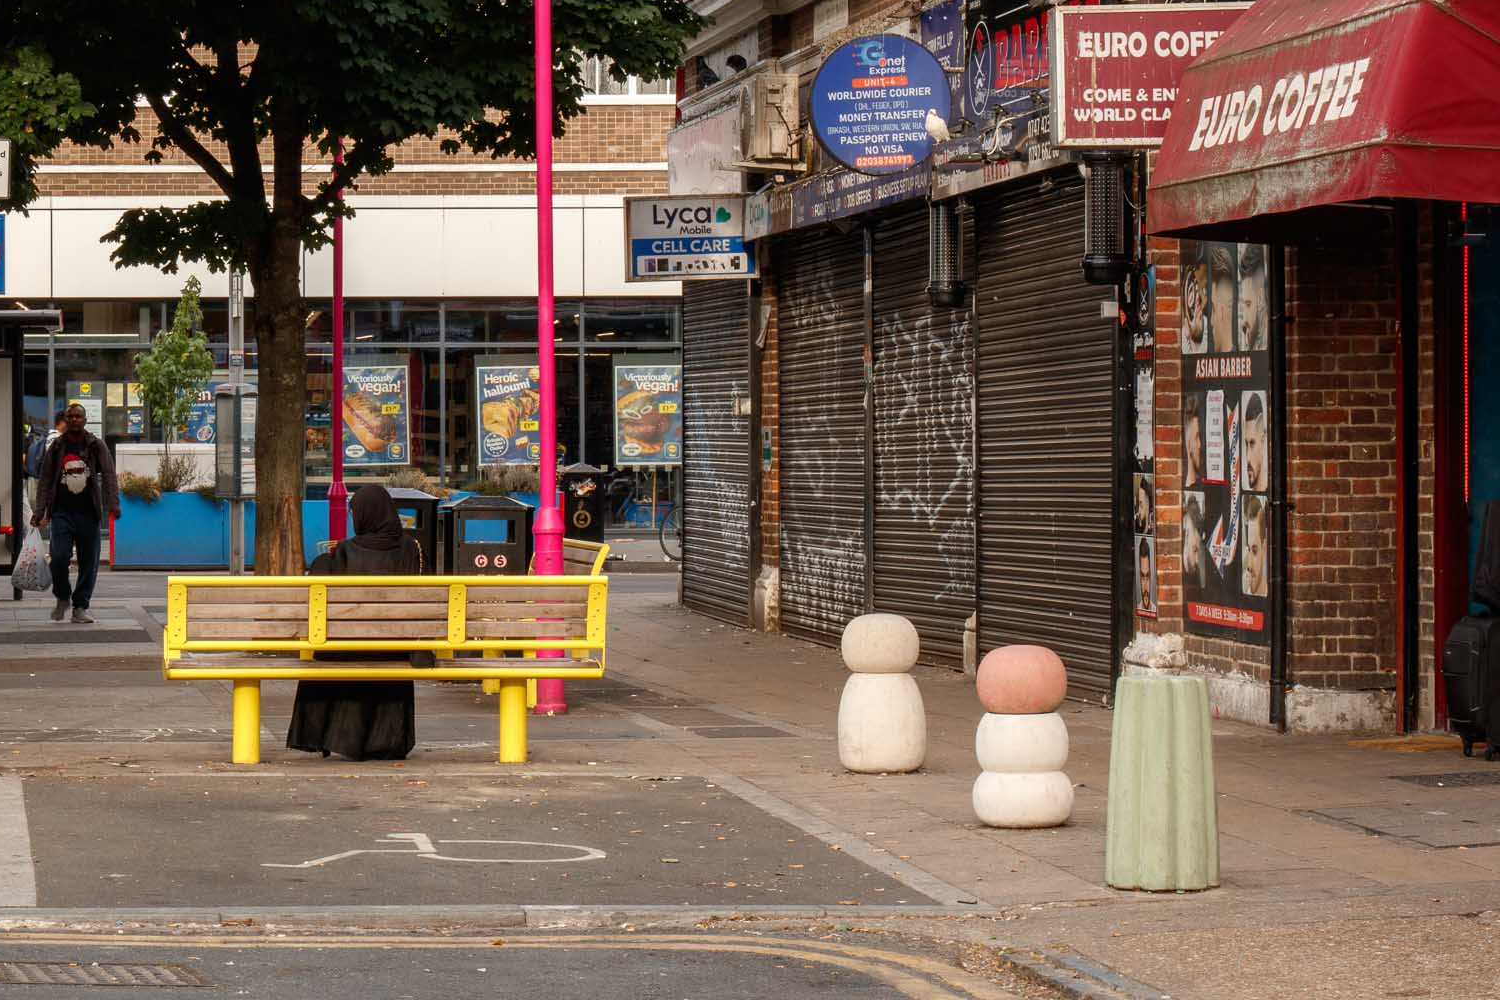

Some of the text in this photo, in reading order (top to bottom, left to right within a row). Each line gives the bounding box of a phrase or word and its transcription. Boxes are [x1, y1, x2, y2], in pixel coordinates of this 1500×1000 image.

[1078, 30, 1224, 58] EURO COFF
[869, 66, 906, 76] Express
[827, 86, 931, 101] WORLDWIDE COURIER
[1083, 87, 1179, 103] COME & EN
[1188, 57, 1371, 152] EURO COFFEE
[839, 109, 925, 123] MONEY TRANSFER
[1074, 107, 1172, 122] WORLD CLA
[840, 132, 928, 145] PASSPORT RENEW
[864, 144, 904, 155] NO VISA
[652, 204, 711, 229] Lyca
[679, 225, 712, 235] Mobile
[651, 239, 731, 254] CELL CARE
[1196, 357, 1252, 378] ASIAN BARBER
[347, 374, 395, 384] Victoriously
[484, 372, 519, 385] Heroic
[624, 373, 672, 383] Victoriously
[358, 380, 400, 396] vegan!
[483, 378, 530, 399] halloumi
[635, 380, 678, 394] vegan!
